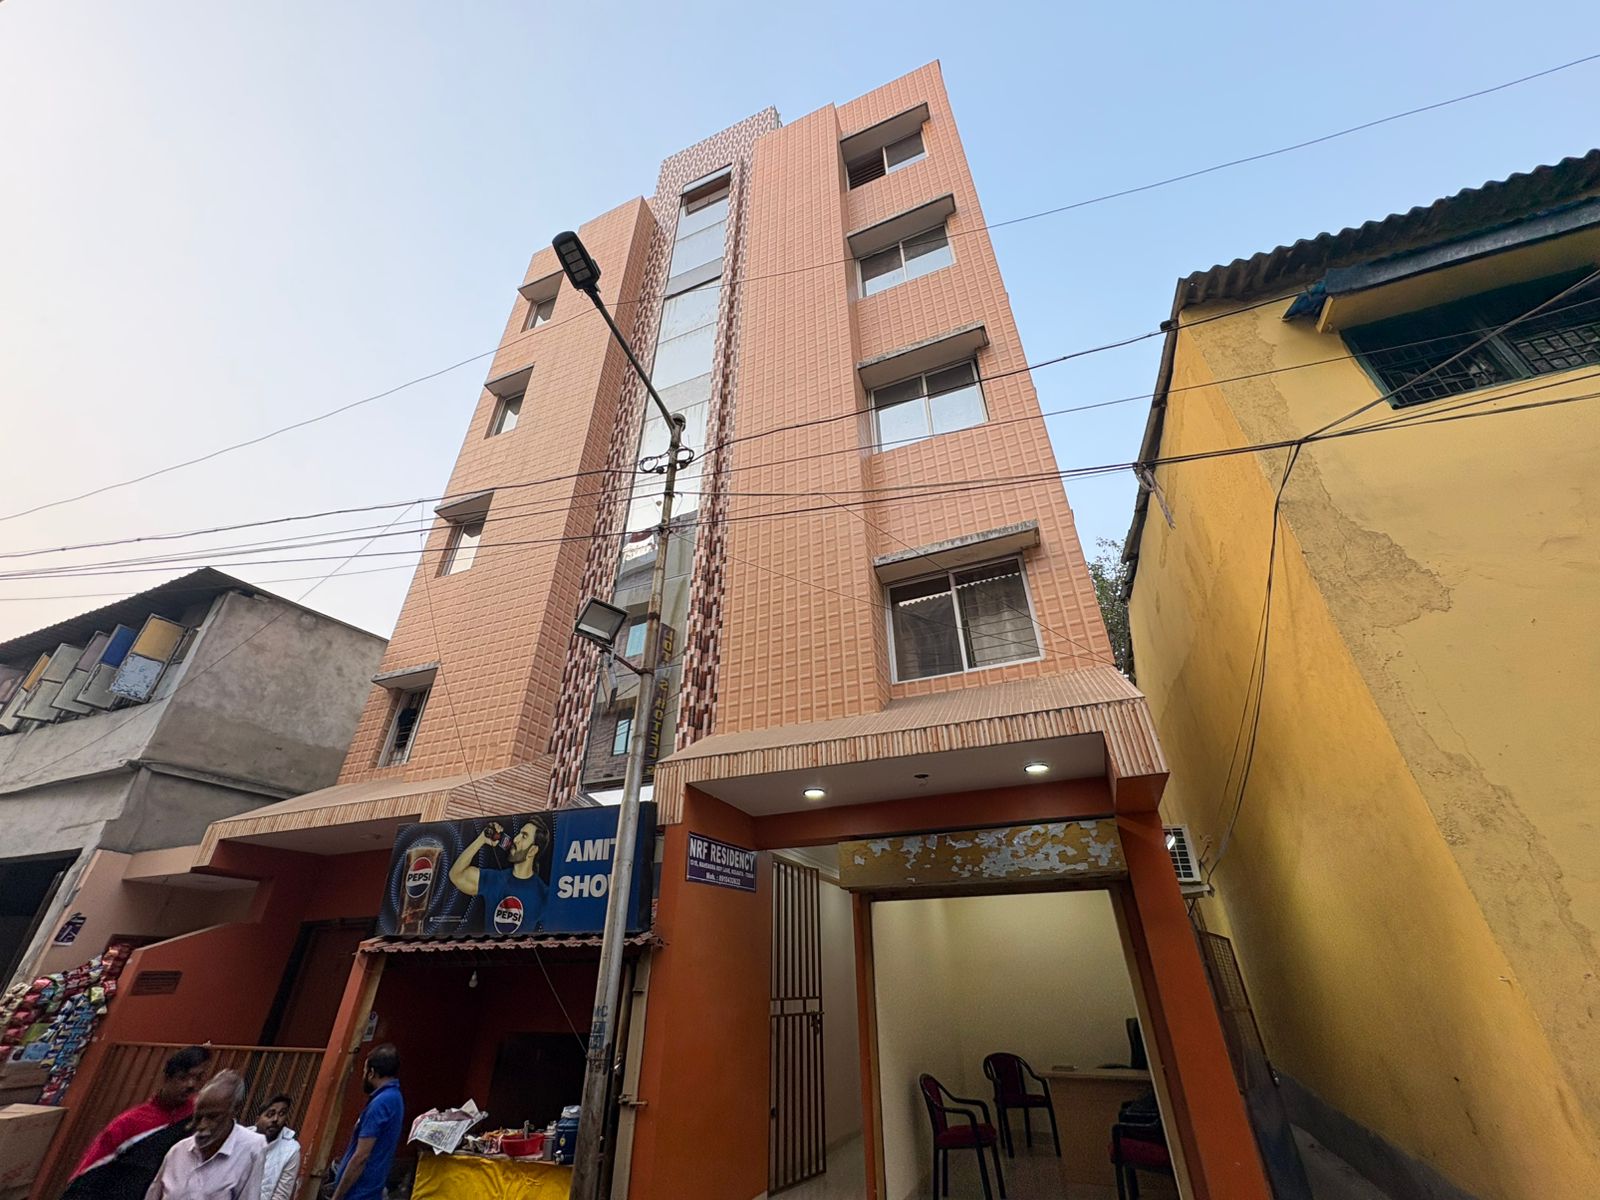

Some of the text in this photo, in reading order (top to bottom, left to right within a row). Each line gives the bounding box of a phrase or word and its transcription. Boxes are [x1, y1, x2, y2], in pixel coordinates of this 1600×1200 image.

[689, 837, 708, 860] NRF
[710, 843, 755, 872] RESIDENCY
[407, 872, 431, 882] PEPSI
[557, 873, 612, 899] SHO
[495, 910, 521, 922] PEPSI
